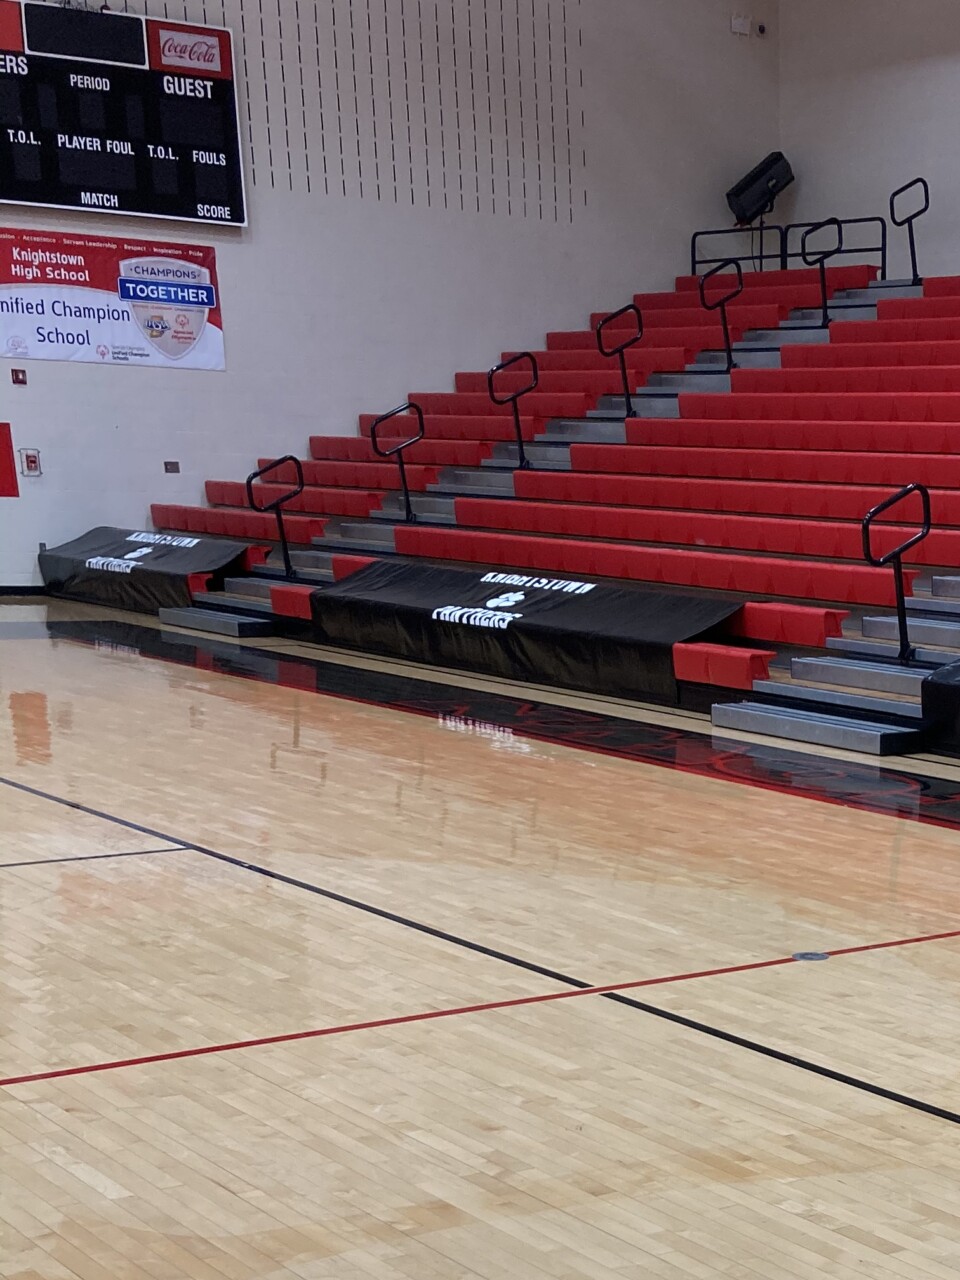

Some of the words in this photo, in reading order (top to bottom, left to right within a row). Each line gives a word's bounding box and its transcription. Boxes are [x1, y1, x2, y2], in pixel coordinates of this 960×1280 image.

[161, 37, 216, 64] Coca-Cola
[70, 74, 110, 91] PERIOD
[163, 75, 213, 99] GUEST
[7, 129, 41, 145] T.O.L.
[57, 134, 101, 151] PLAYER
[106, 140, 135, 156] FOUL
[147, 144, 179, 161] T.O.L.
[192, 150, 226, 166] FOULS
[80, 191, 119, 208] MATCH
[197, 203, 231, 220] SCORE
[12, 246, 84, 266] Knightstown
[11, 264, 40, 280] High
[45, 266, 90, 281] School
[134, 265, 197, 280] CHAMPIONS
[125, 283, 208, 302] TOGETHER
[51, 300, 131, 324] Champion
[36, 326, 91, 346] School
